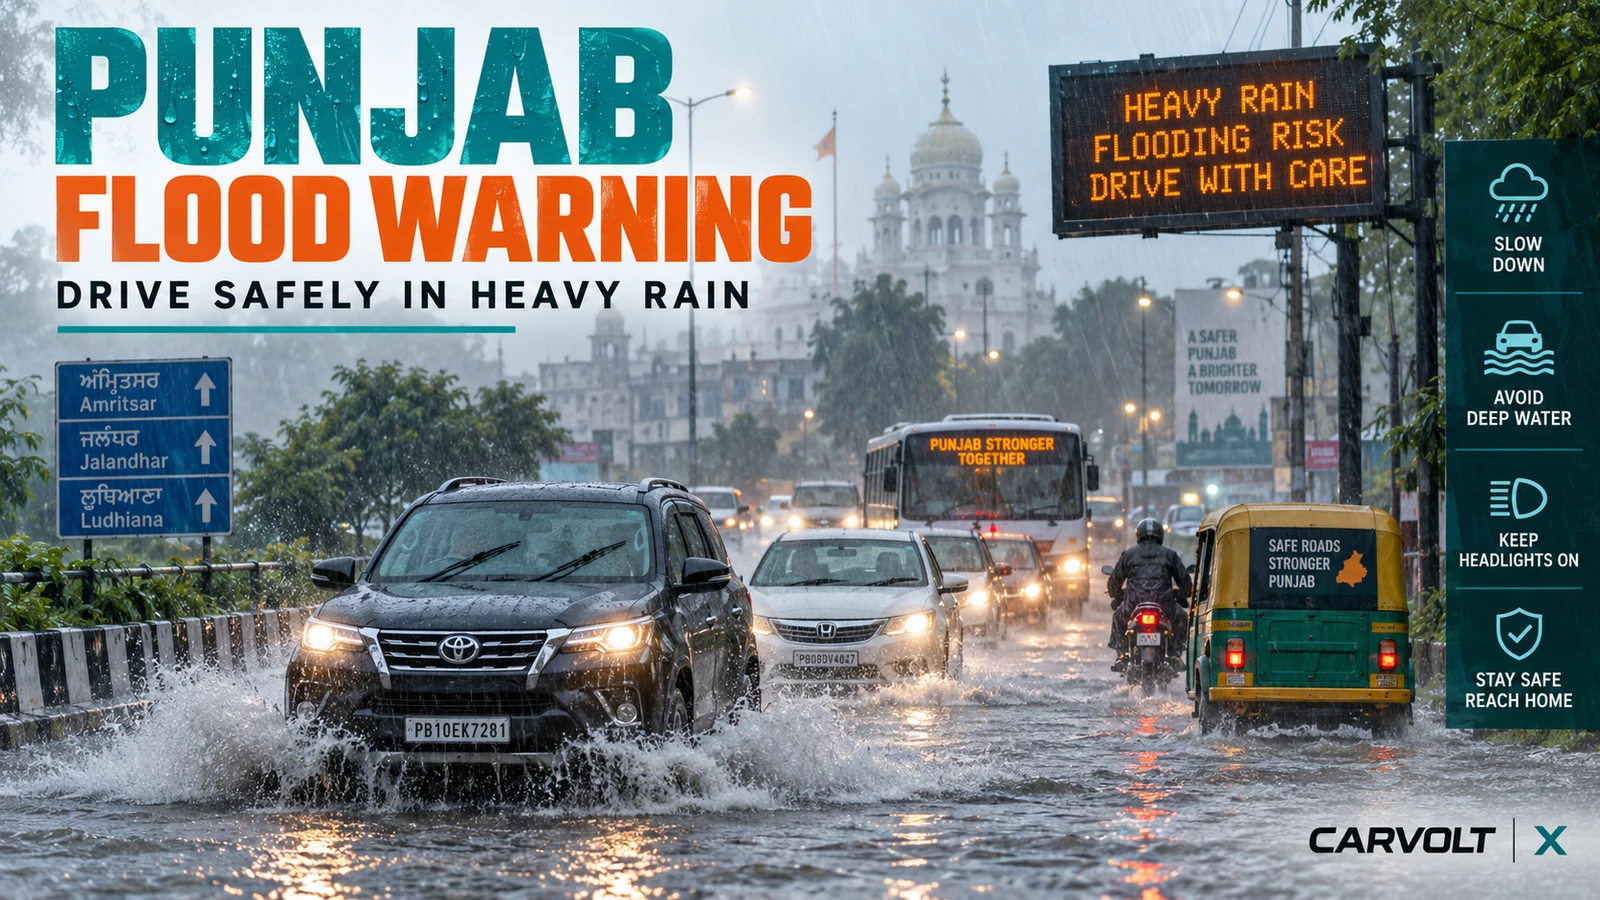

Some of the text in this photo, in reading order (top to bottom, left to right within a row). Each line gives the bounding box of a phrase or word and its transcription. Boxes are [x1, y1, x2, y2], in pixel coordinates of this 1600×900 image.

[1125, 81, 1314, 122] HEAVY RAIN
[1094, 118, 1344, 163] FLOODING RISK
[1090, 156, 1366, 201] DRIVE WITH CARE
[1188, 329, 1237, 344] A SAFER
[1188, 346, 1236, 360] PUNJAB
[1188, 363, 1258, 378] A BRIGHTER
[1188, 380, 1261, 394] TOMORROW
[80, 397, 156, 412] Amritsar
[930, 438, 1054, 451] PUNJAB STRONGER
[80, 453, 168, 470] Jalandhar
[958, 451, 1025, 465] TOGETHER
[82, 512, 162, 528] Ludhiana
[1269, 539, 1340, 552] SAFE ROADS
[1269, 557, 1330, 570] STRONGER
[1270, 575, 1314, 587] PUNJAB
[415, 722, 506, 738] PB10EK7281
